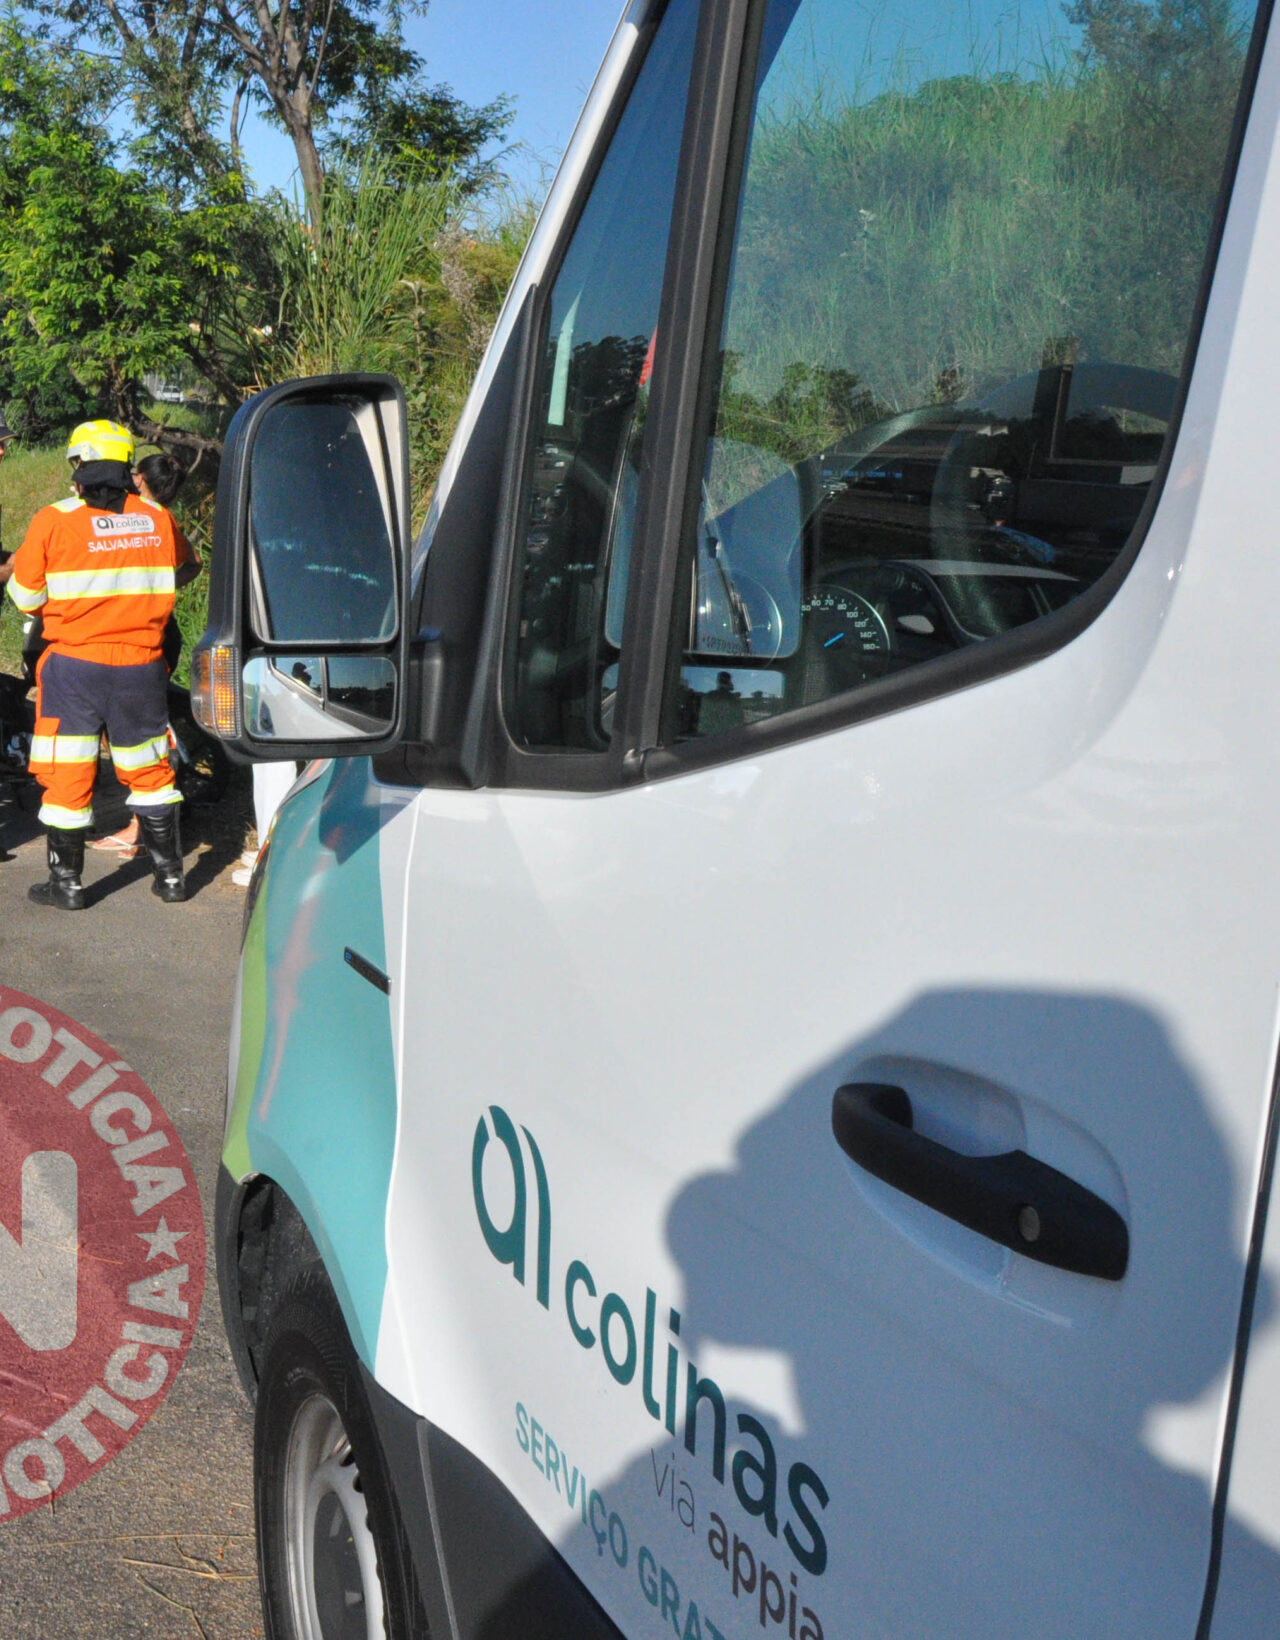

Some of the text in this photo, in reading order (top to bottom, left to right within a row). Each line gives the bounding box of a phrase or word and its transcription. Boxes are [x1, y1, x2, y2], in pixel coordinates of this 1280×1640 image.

[88, 536, 162, 552] SALVAMENTO
[116, 517, 149, 528] colinas
[515, 1401, 629, 1568] SERVIÇO
[564, 1259, 831, 1577] colinas
[650, 1447, 824, 1640] via appia
